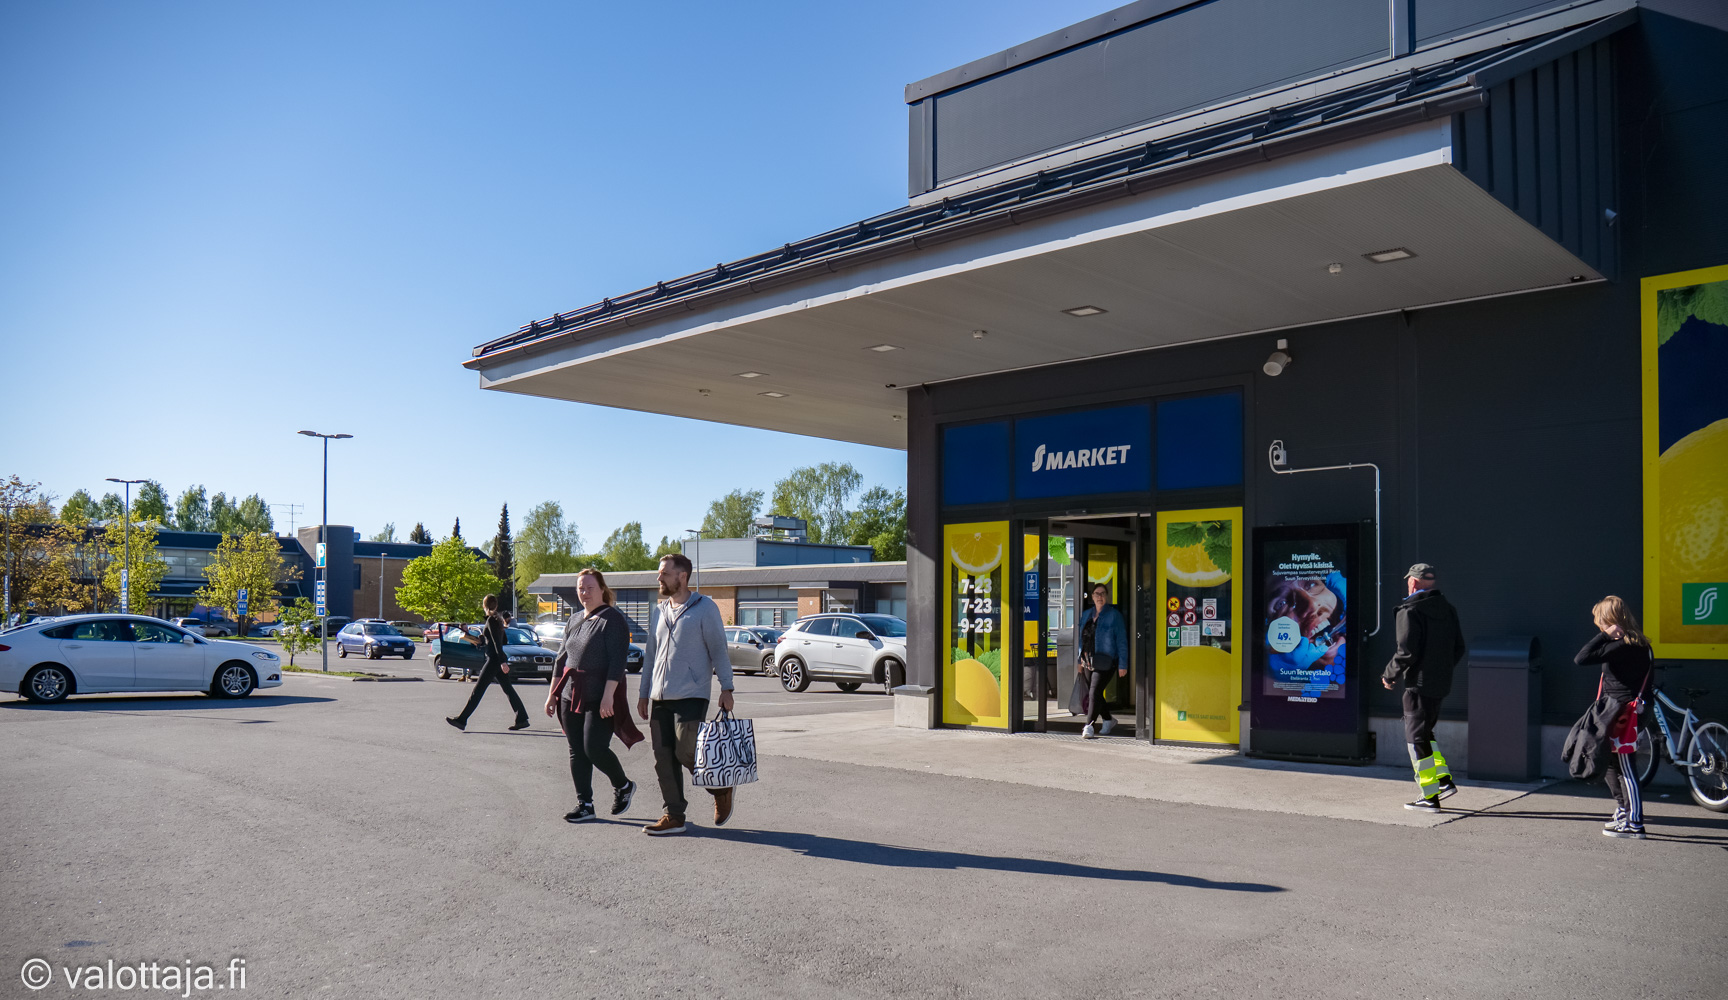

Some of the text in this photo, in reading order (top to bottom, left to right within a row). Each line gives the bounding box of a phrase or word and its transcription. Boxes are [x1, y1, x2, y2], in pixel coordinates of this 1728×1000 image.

[318, 545, 324, 566] P
[1292, 562, 1312, 570] hyvissä
[962, 578, 992, 594] 7-23
[240, 590, 246, 599] P
[962, 598, 992, 614] 7-23
[960, 618, 992, 634] 9-23
